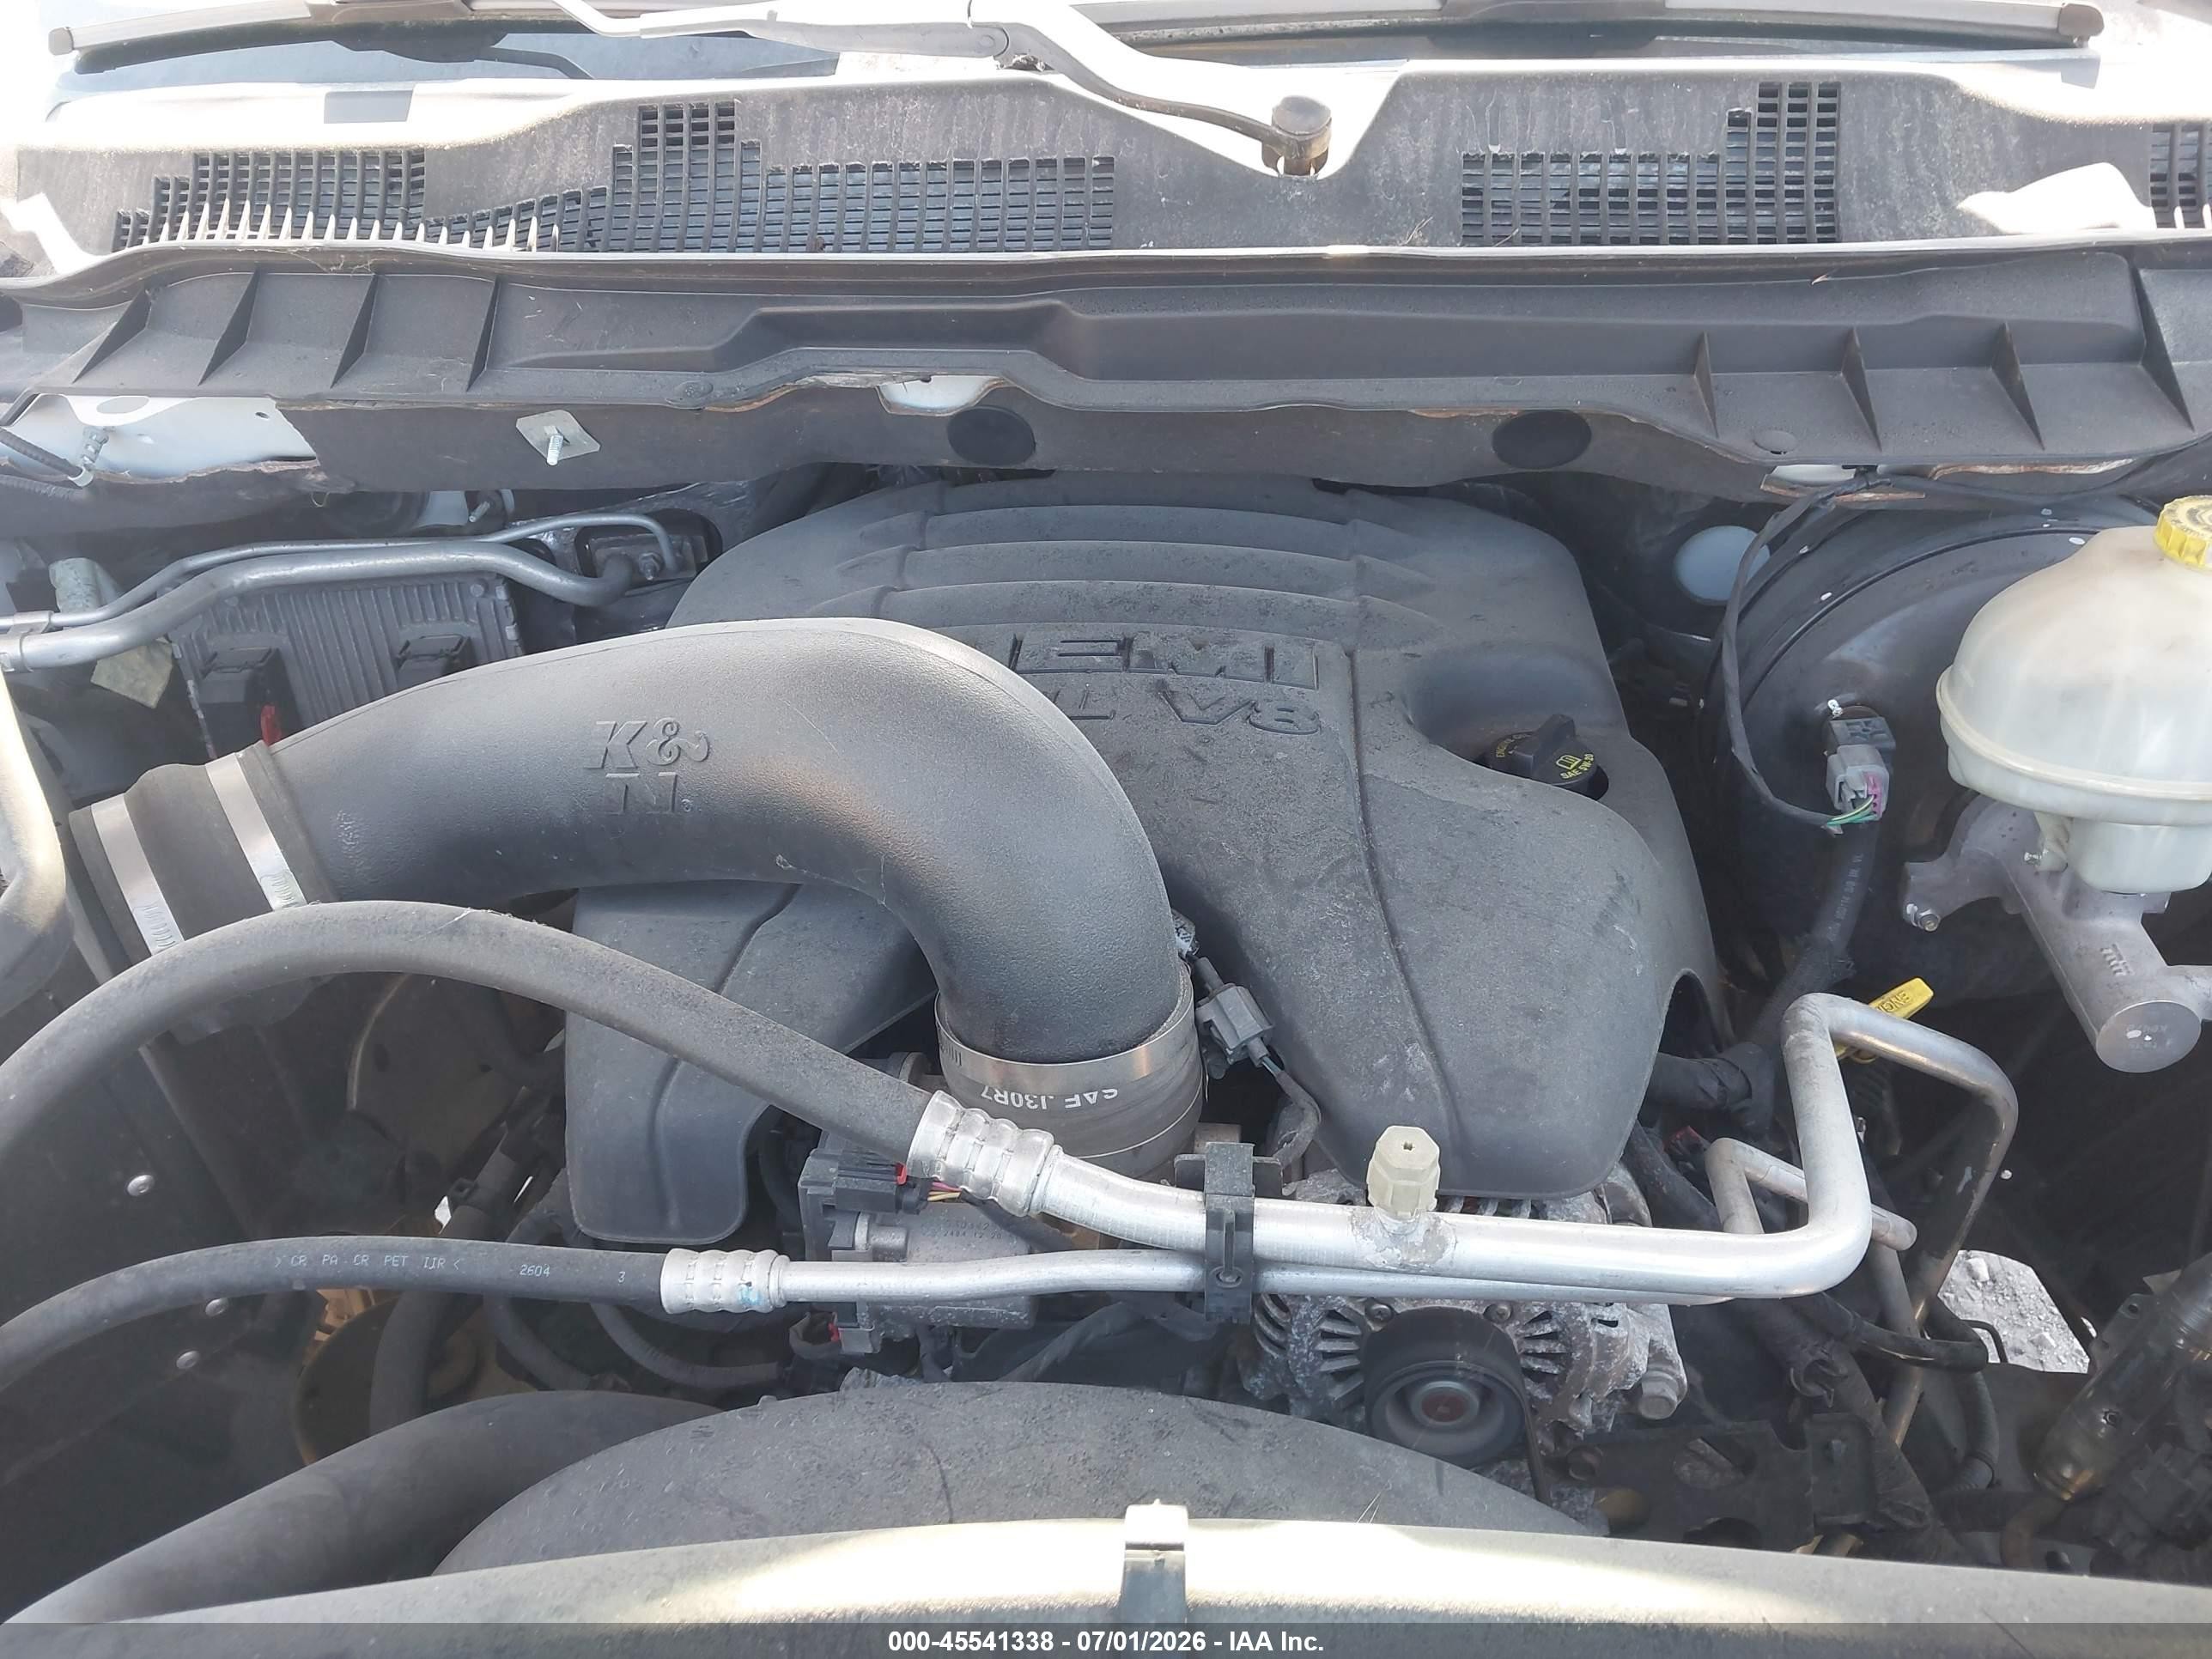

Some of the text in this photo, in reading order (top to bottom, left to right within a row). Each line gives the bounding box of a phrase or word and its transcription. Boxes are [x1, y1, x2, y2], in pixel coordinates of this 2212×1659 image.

[1157, 683, 1322, 734] V8
[1875, 990, 1911, 1013] ENGI
[384, 1255, 409, 1267] PET
[519, 1263, 551, 1278] 2604
